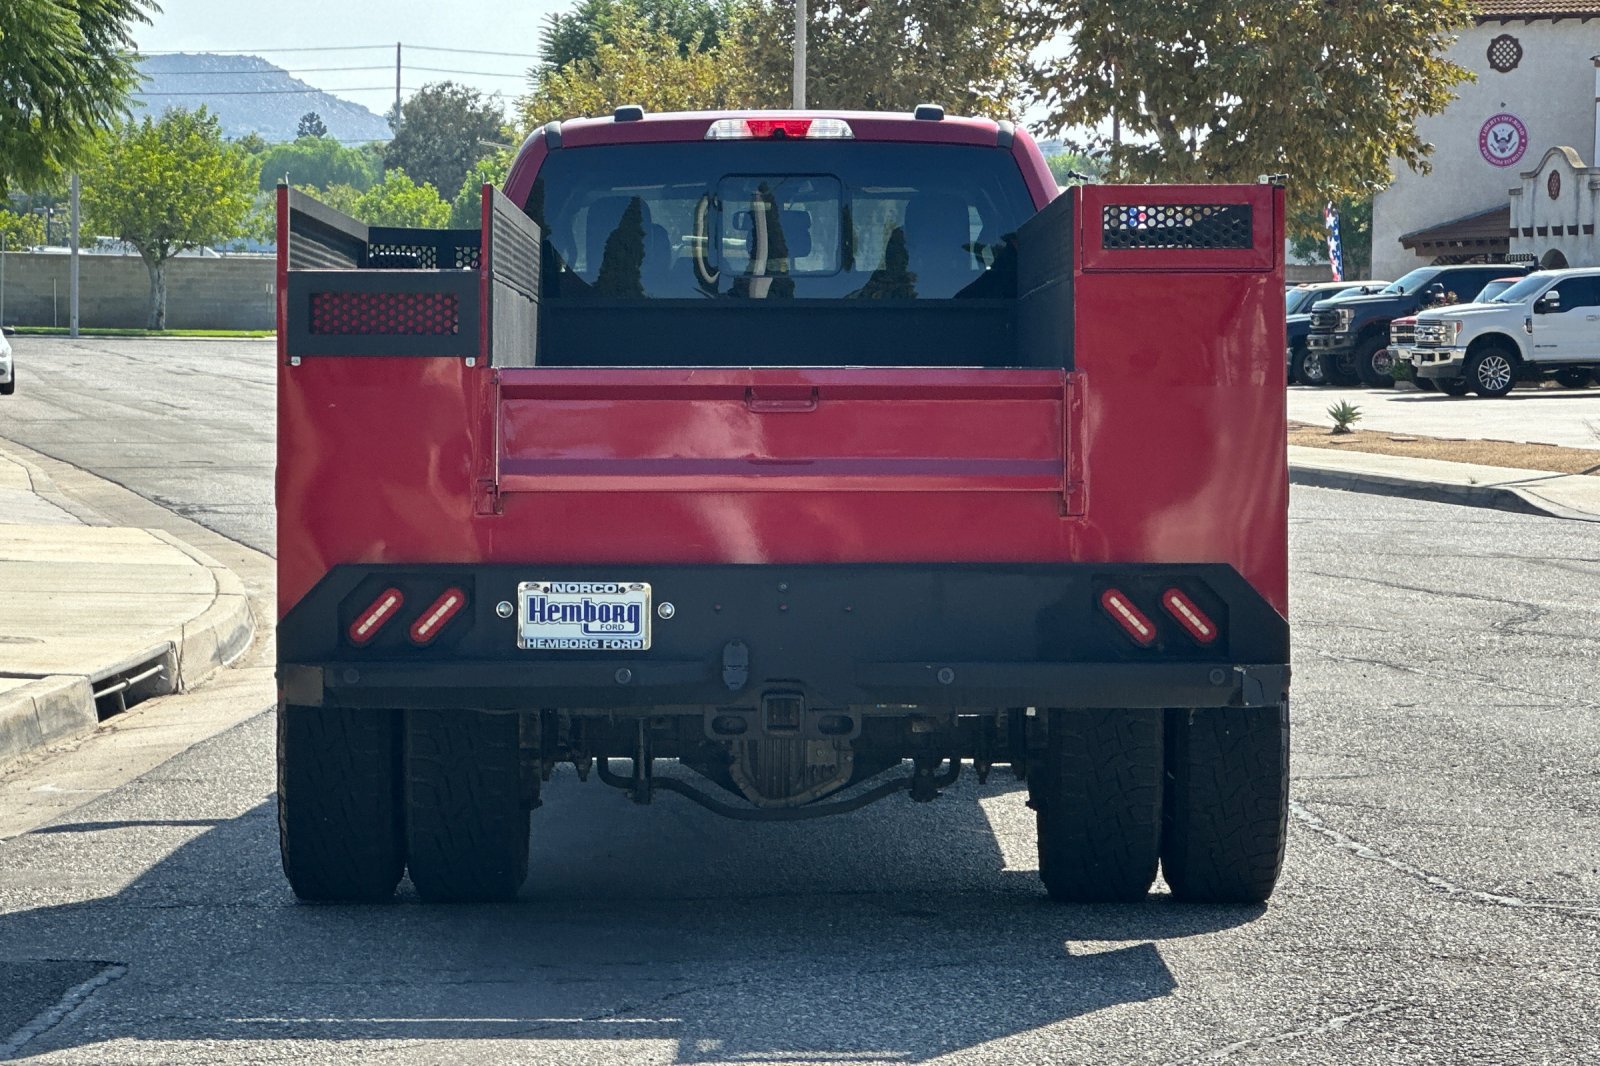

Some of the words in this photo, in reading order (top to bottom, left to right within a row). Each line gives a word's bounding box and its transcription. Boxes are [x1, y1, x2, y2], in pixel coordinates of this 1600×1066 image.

[551, 583, 617, 594] NORCO
[528, 597, 641, 633] Hemborg
[600, 623, 625, 631] FORD
[527, 639, 599, 649] HEMBORG
[602, 639, 642, 649] FORD
